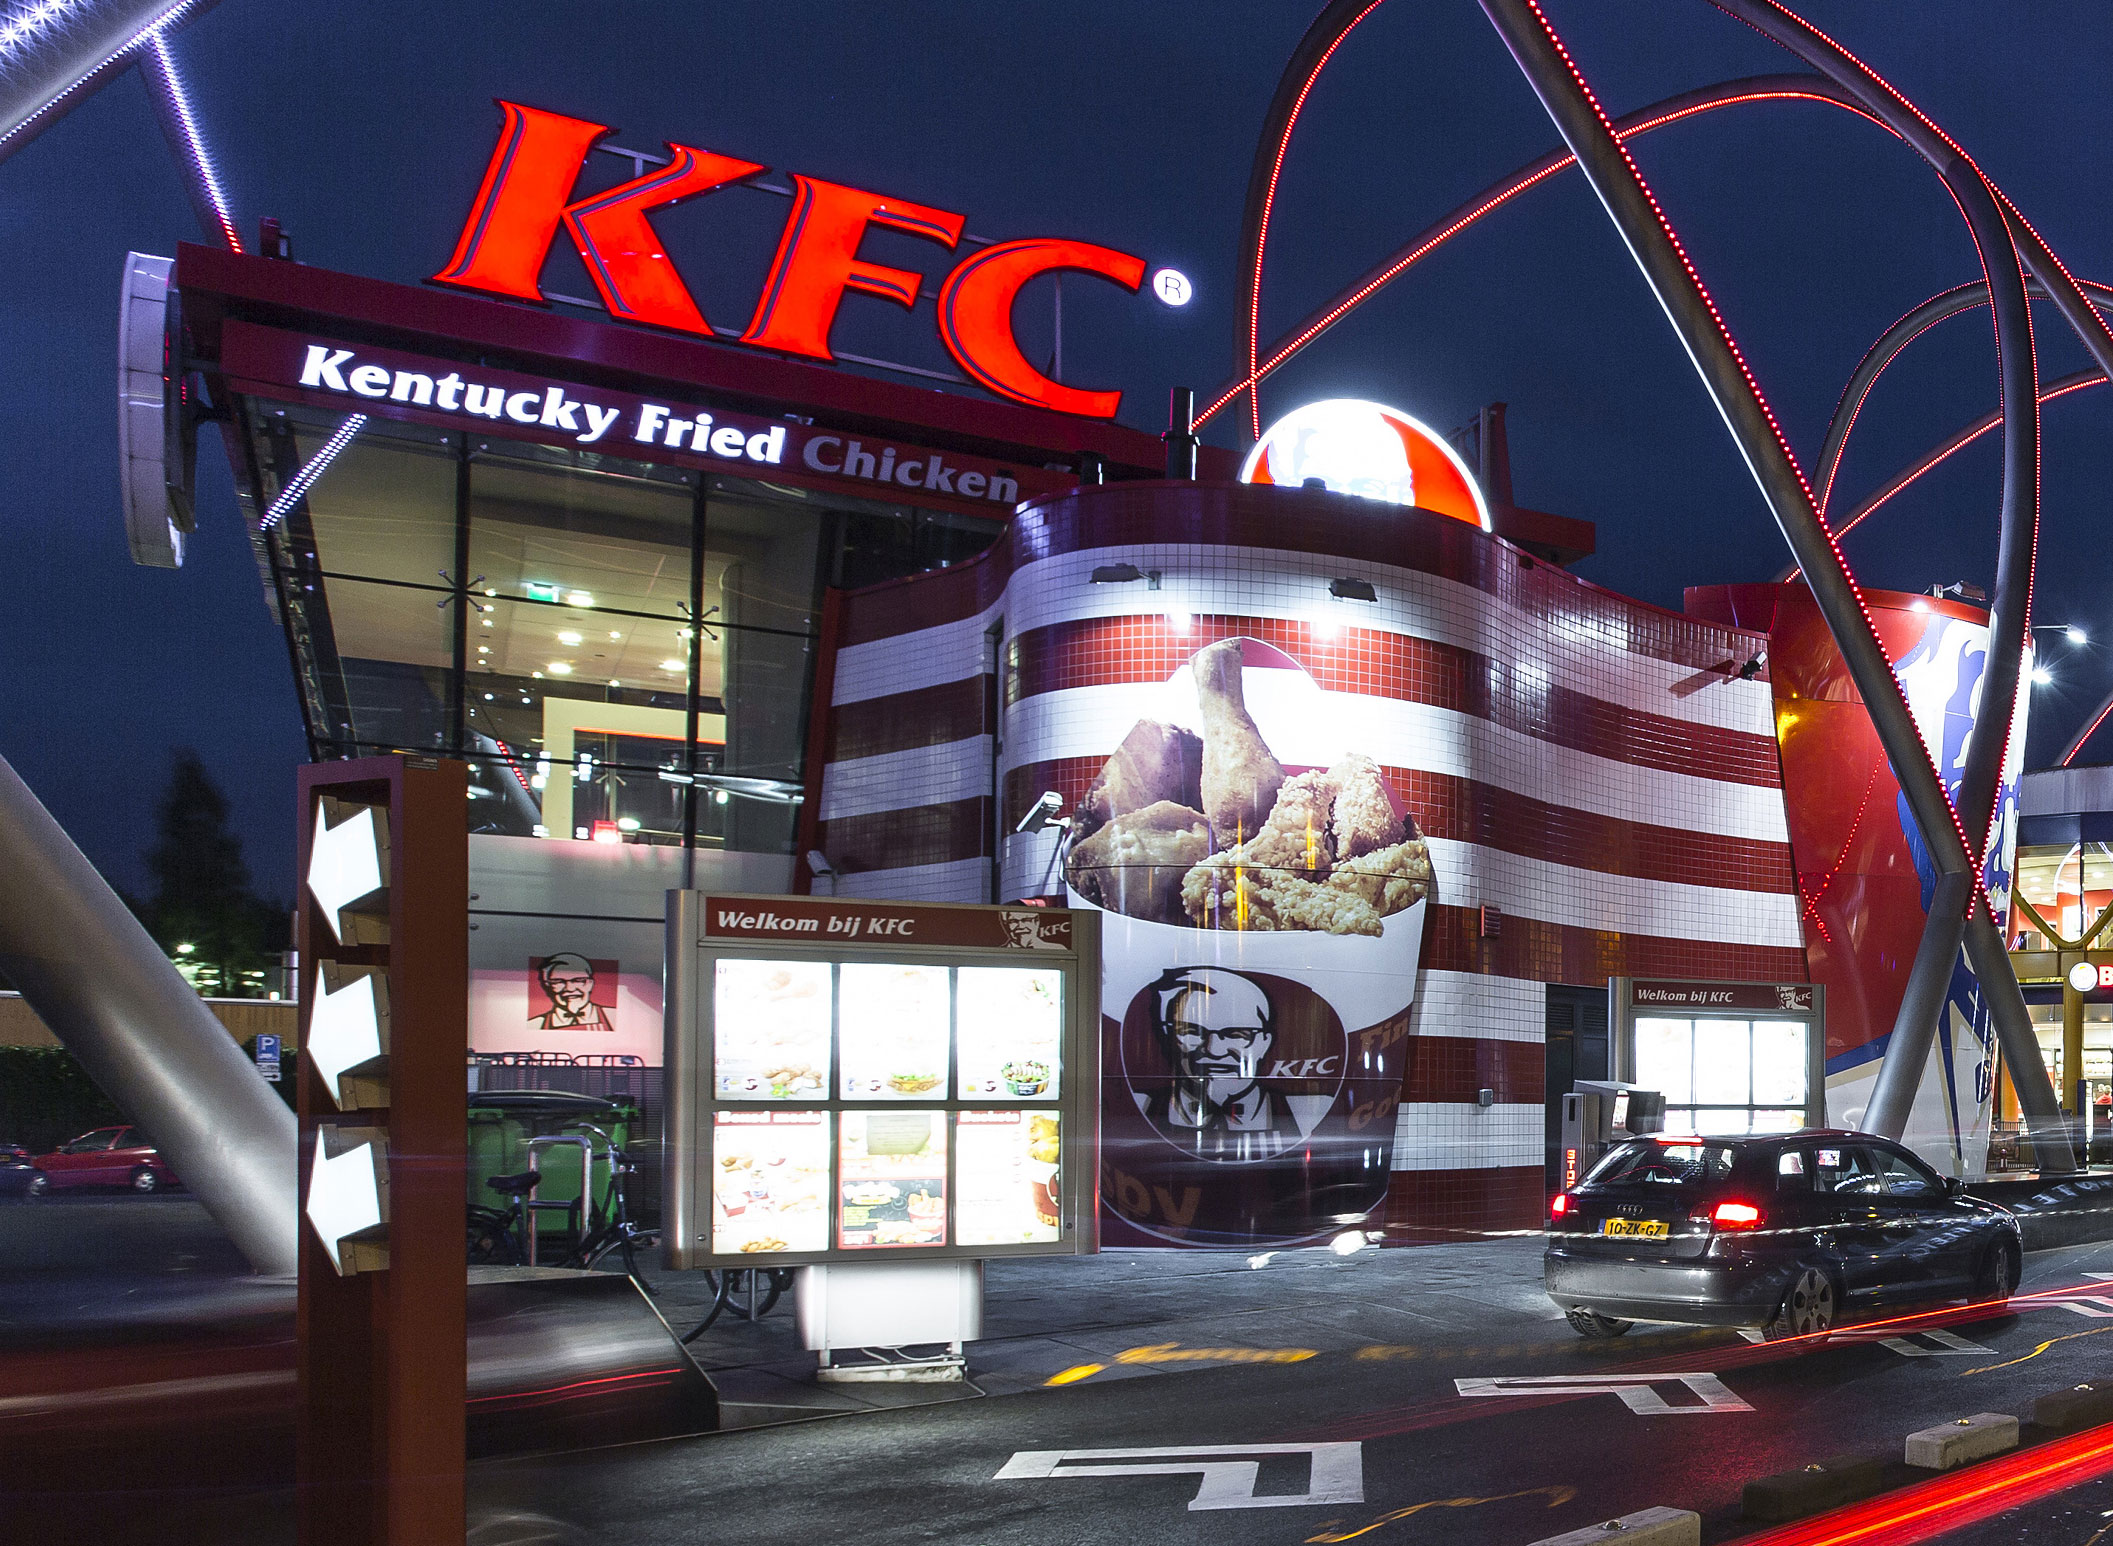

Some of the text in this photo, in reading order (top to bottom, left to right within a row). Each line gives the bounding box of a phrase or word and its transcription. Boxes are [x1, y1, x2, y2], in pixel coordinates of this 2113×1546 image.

[431, 99, 1149, 419] KFC
[299, 344, 1019, 503] Kentucky Fried Chicken
[717, 911, 916, 937] Welkom bij KFC
[1039, 921, 1071, 939] KFC
[1637, 989, 1734, 1004] Welkom bij KFC
[1795, 991, 1812, 1003] KFC
[261, 1037, 275, 1050] P
[1269, 1055, 1339, 1077] KFC
[1609, 1222, 1662, 1236] 10-ZK-GZ
